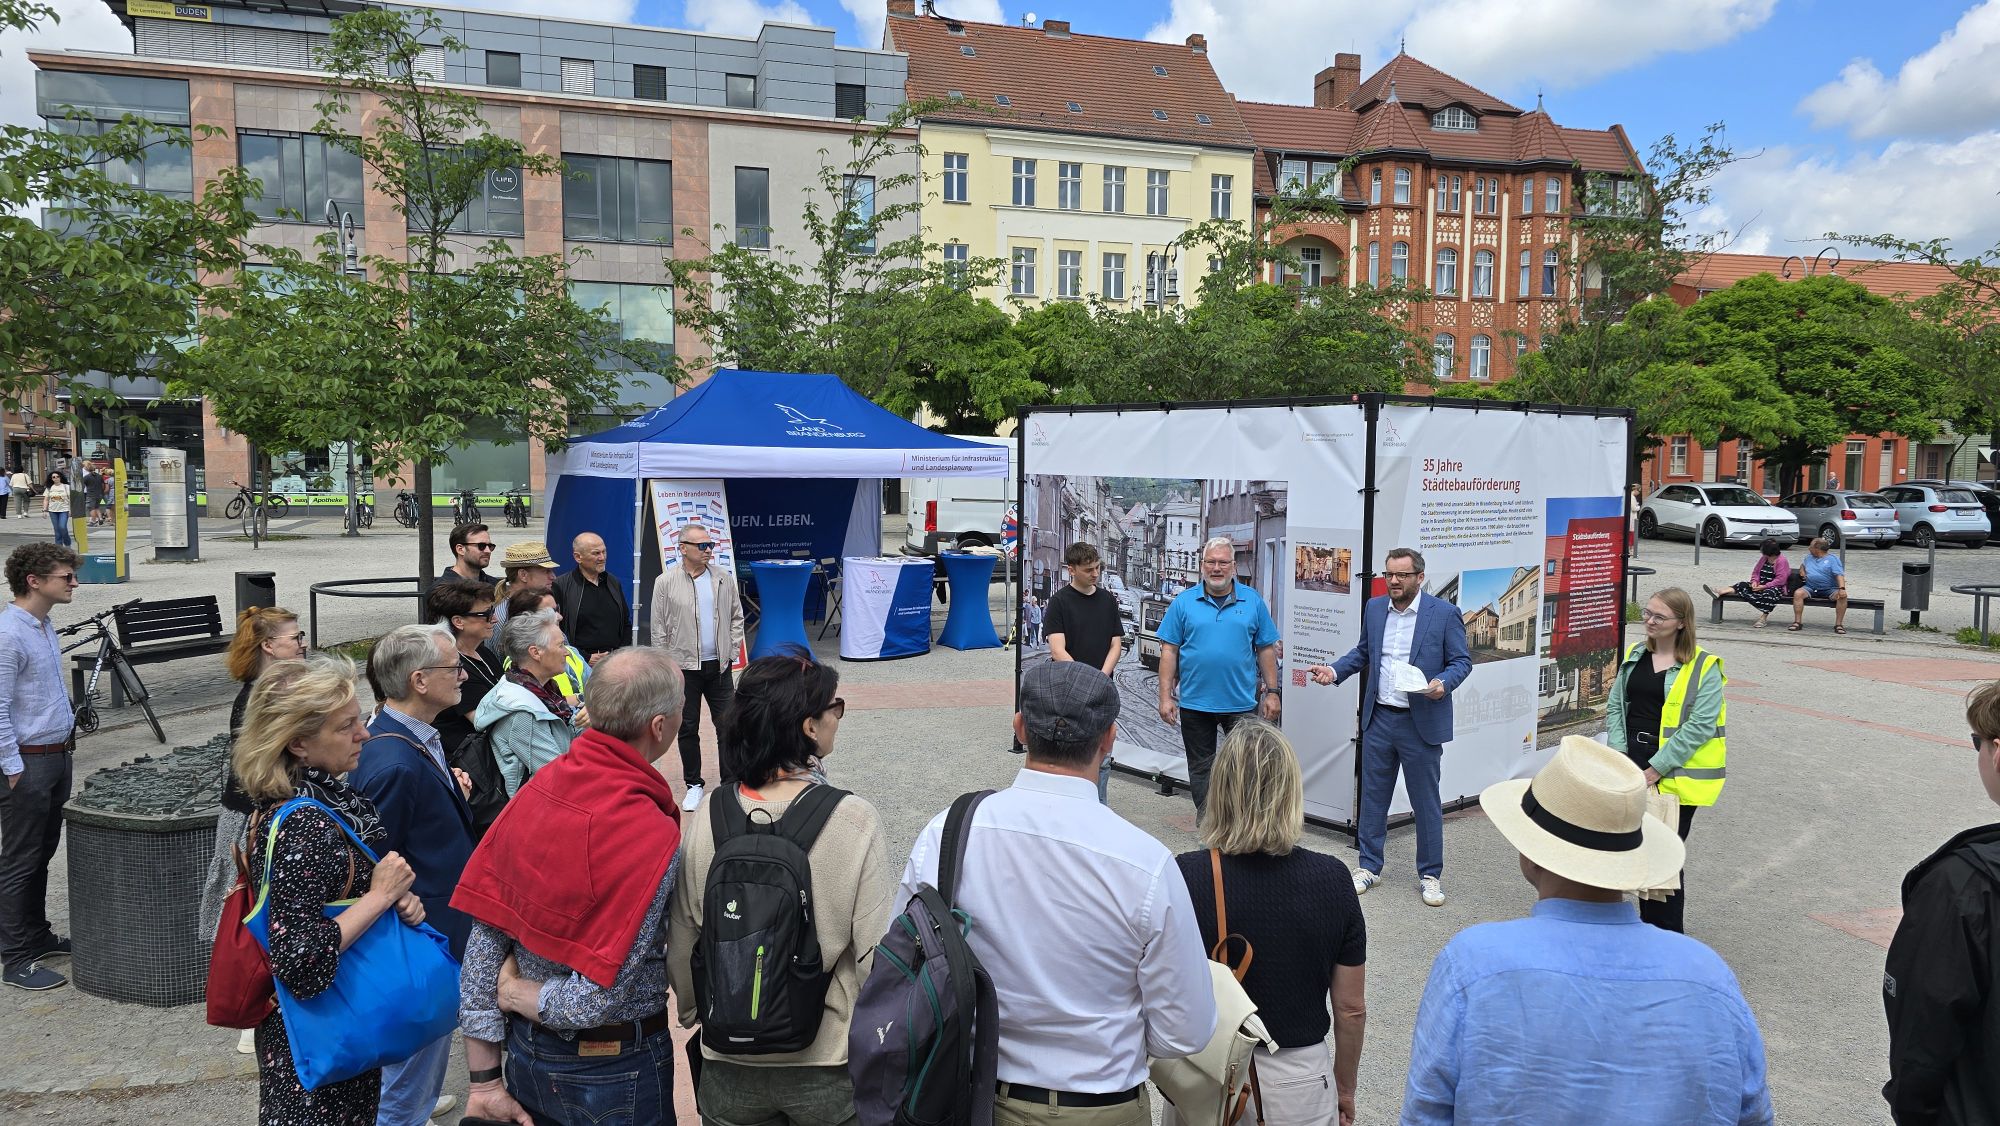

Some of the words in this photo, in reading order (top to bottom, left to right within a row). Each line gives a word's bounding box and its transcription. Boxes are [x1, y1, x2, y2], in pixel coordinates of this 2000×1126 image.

[175, 7, 206, 16] DUDEN
[1423, 459, 1434, 471] 35
[1436, 459, 1463, 475] Jahre
[1422, 478, 1520, 494] Städtebauförderung
[684, 490, 720, 498] Brandenburg
[731, 515, 764, 527] UEN.
[768, 514, 814, 527] LEBEN.
